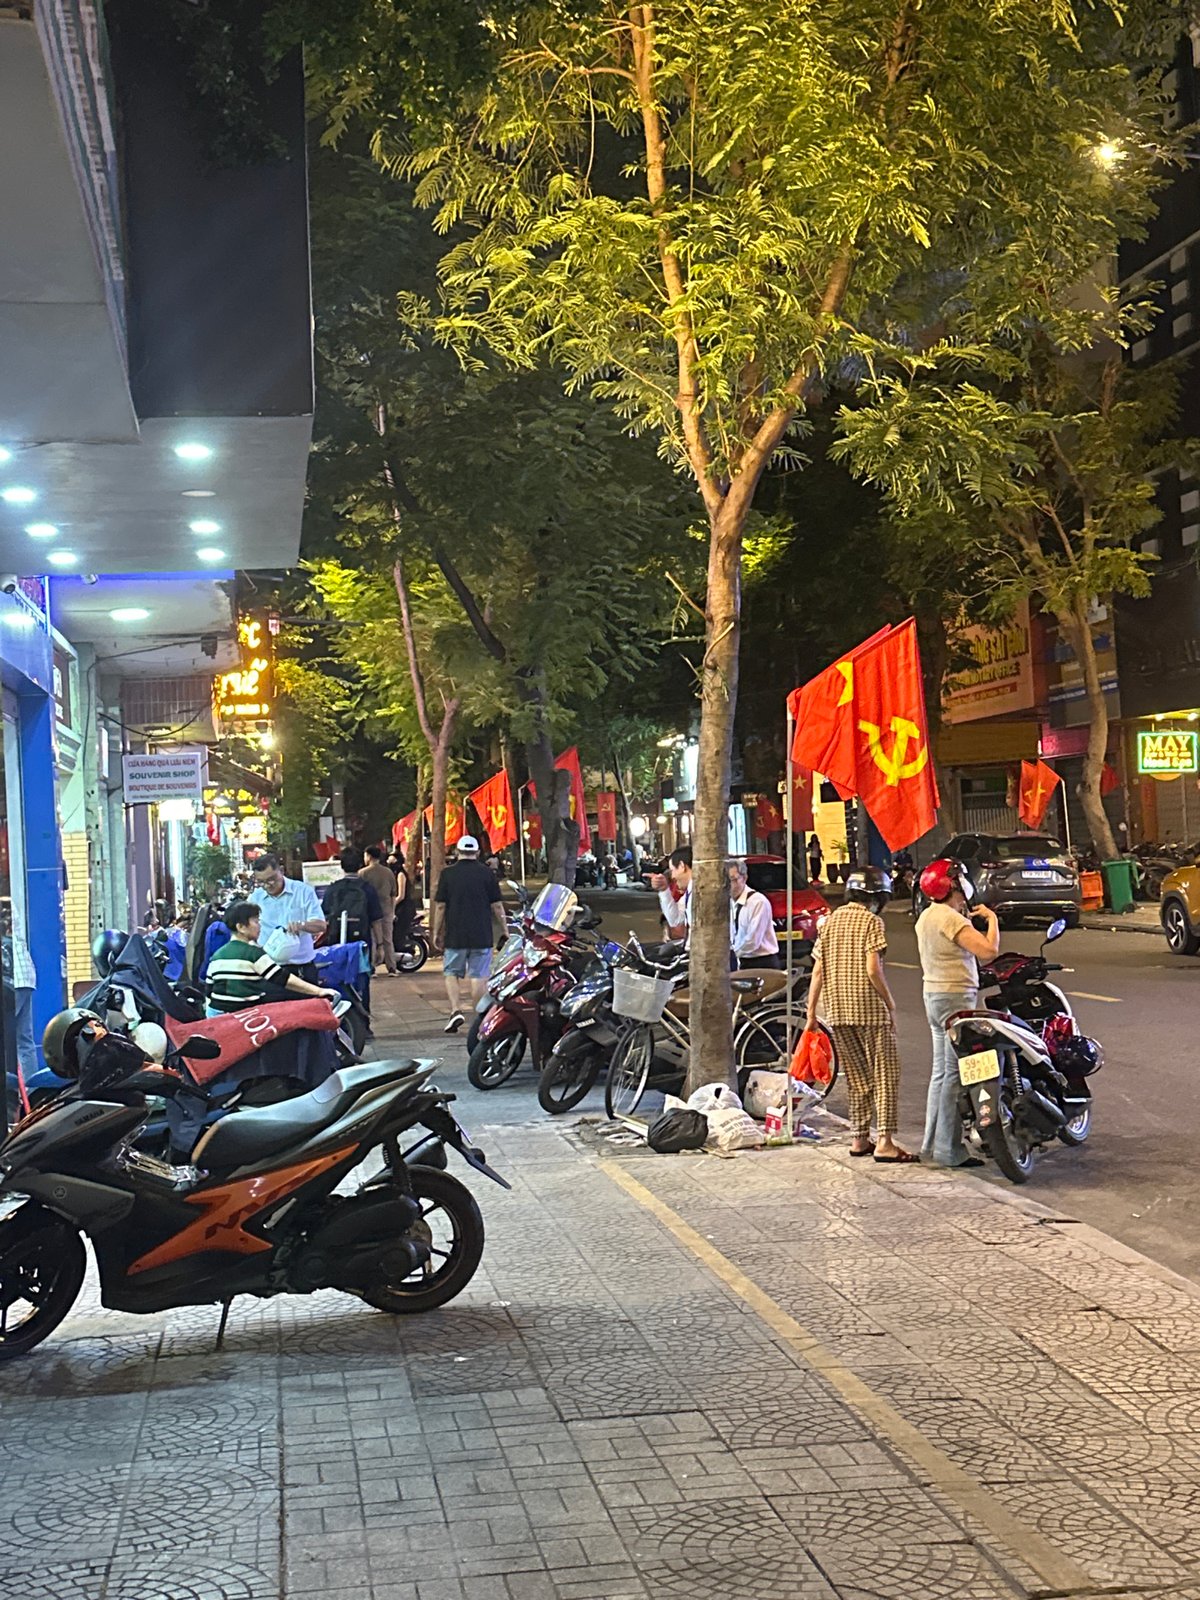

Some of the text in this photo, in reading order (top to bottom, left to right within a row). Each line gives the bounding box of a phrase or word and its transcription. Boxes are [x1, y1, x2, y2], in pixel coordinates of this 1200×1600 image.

[1145, 735, 1191, 751] MAY
[129, 770, 196, 780] SOUVENIR SHOP
